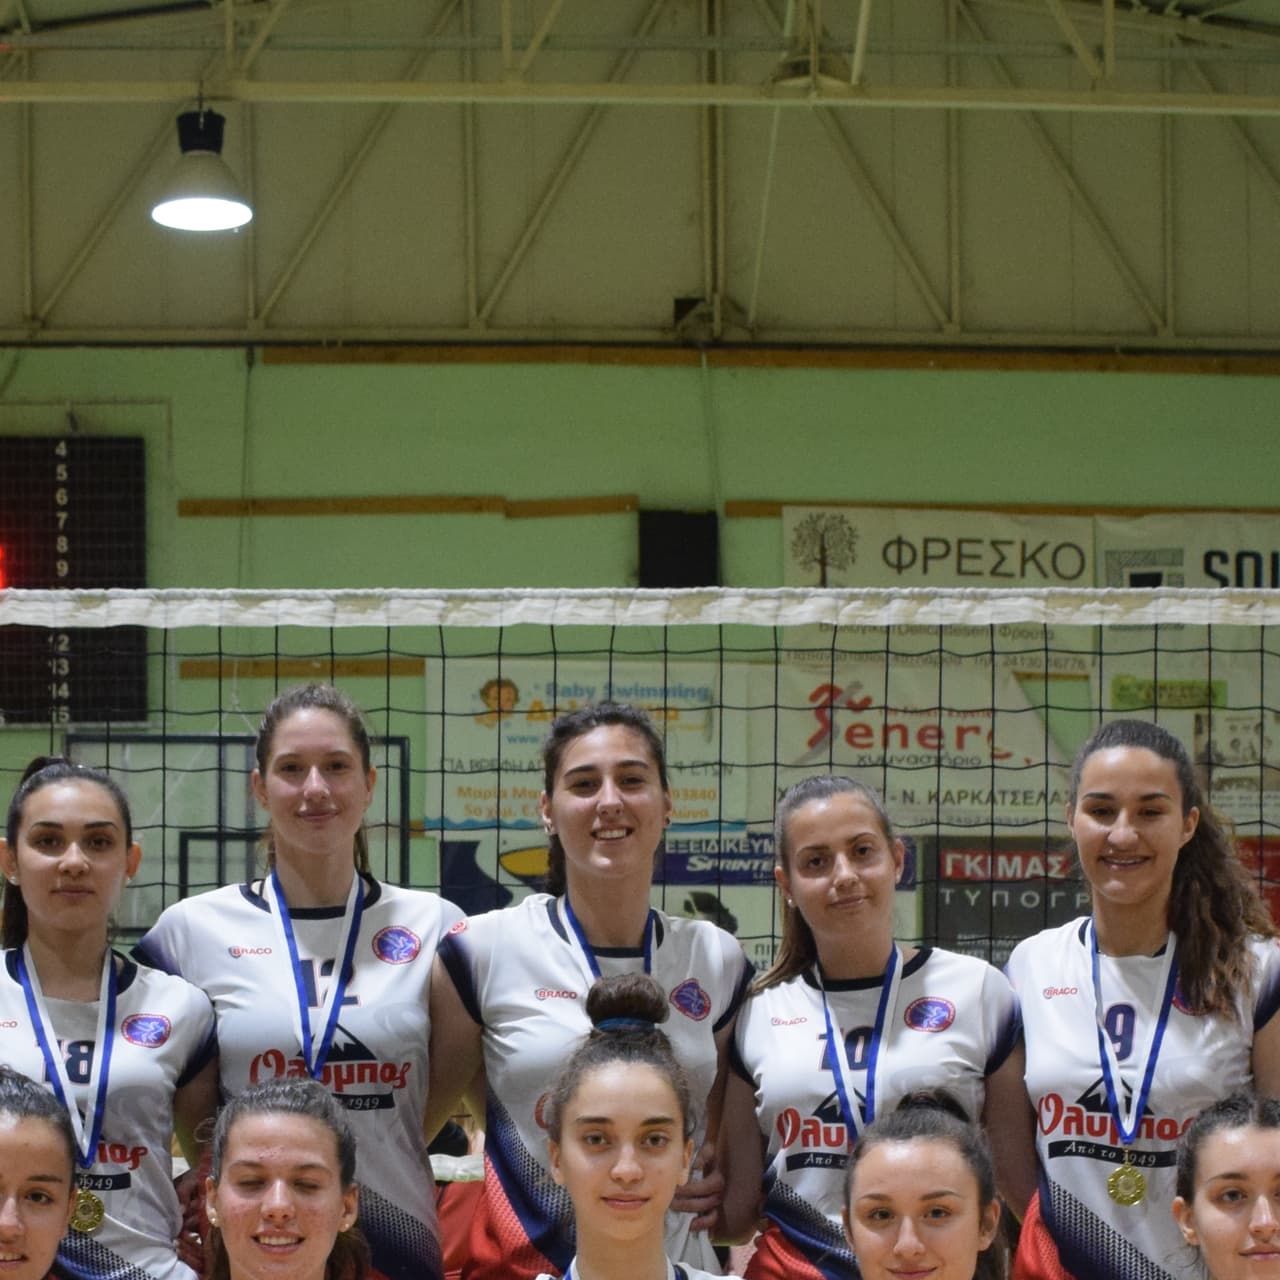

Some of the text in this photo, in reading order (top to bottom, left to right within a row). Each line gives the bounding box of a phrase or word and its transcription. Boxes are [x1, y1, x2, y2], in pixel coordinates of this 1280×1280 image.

[53, 441, 67, 457] 4
[55, 465, 69, 481] 5
[55, 489, 69, 506] 6
[55, 513, 69, 529] 7
[55, 536, 69, 552] 8
[882, 534, 1087, 580] ΦΡΕΣΚΟ
[55, 560, 69, 577] 9
[545, 683, 596, 699] Baby
[686, 855, 771, 871] SPRINTE
[1104, 1003, 1136, 1062] 9
